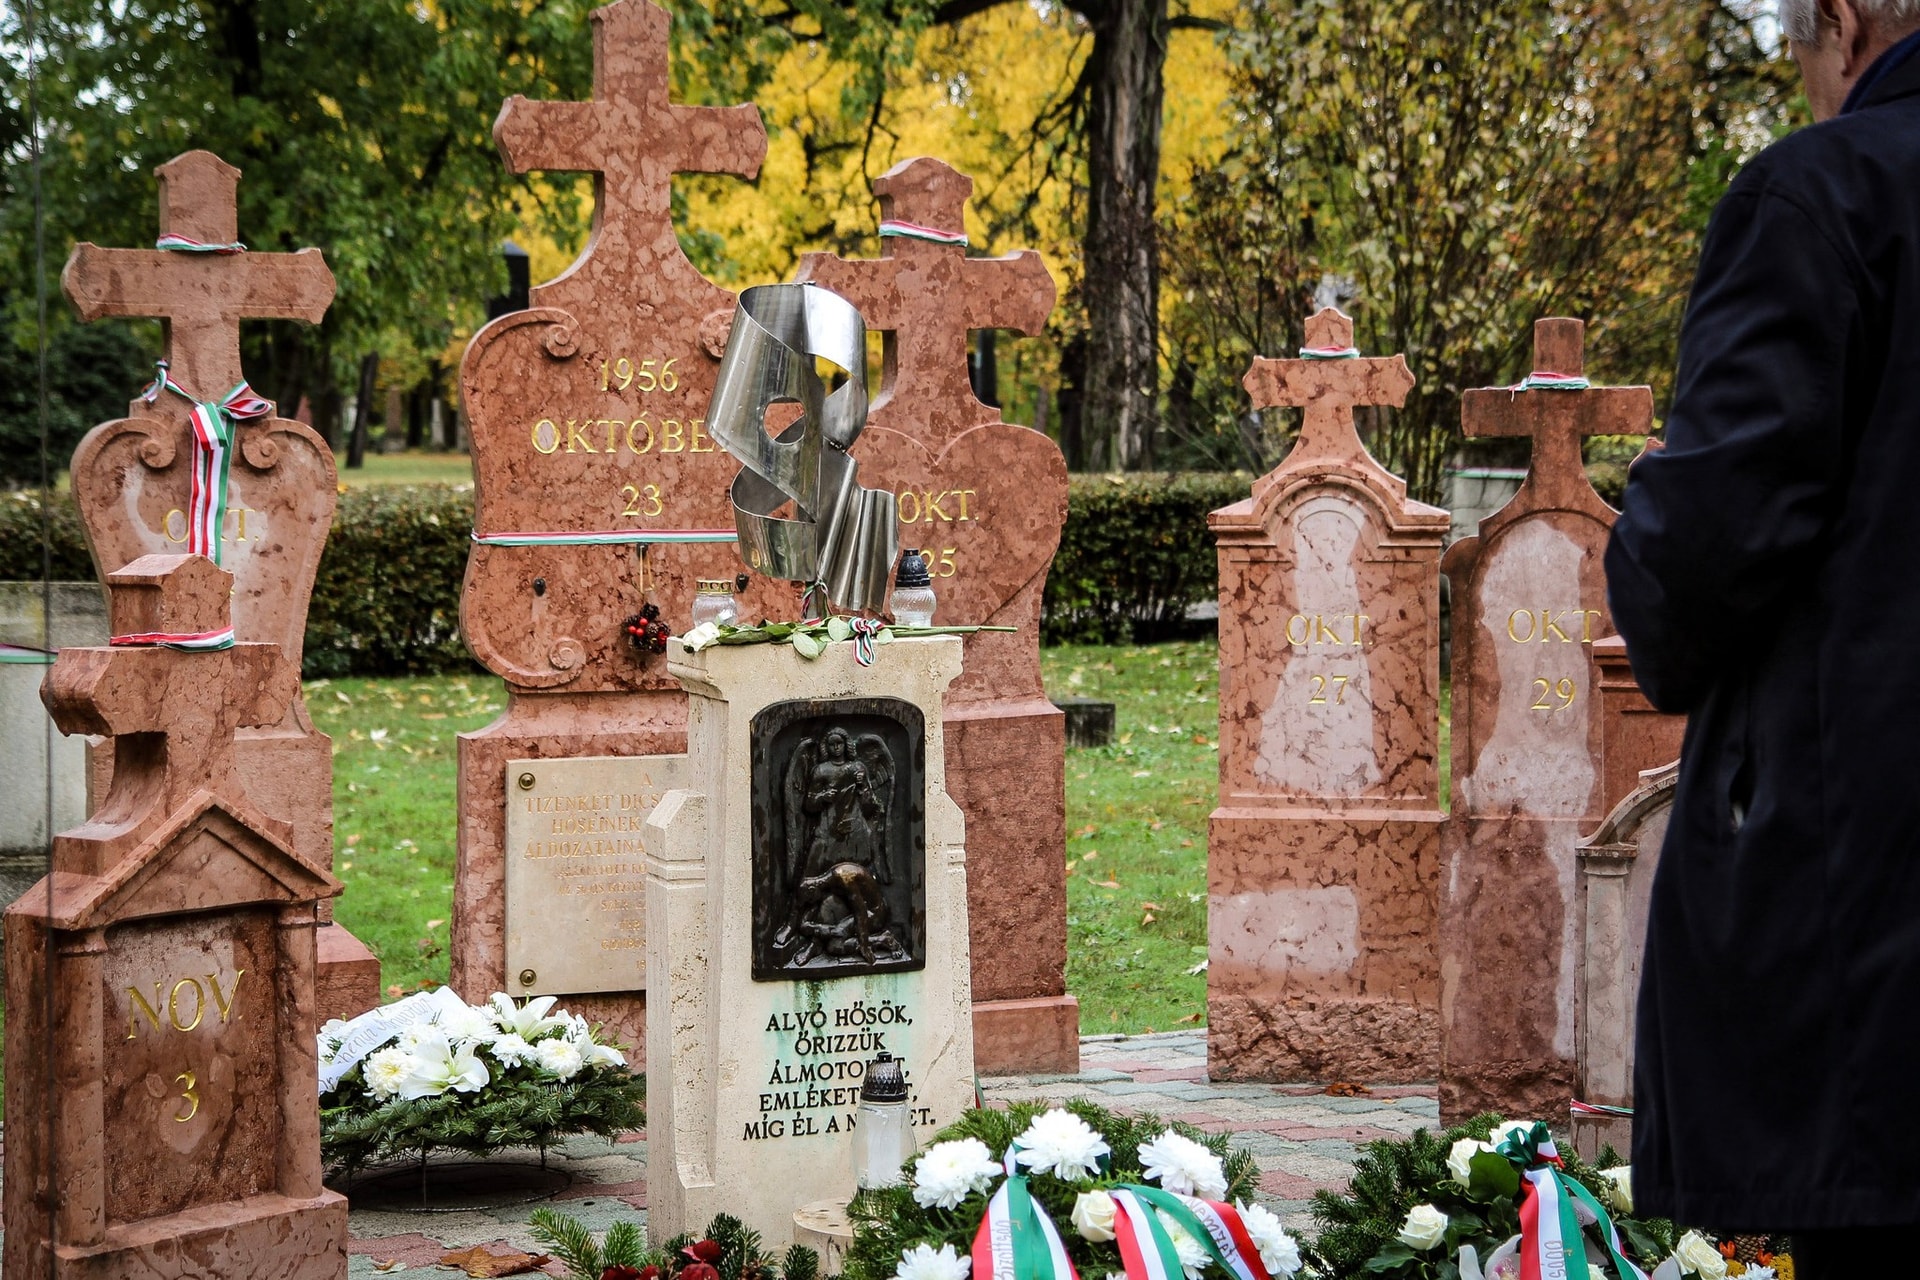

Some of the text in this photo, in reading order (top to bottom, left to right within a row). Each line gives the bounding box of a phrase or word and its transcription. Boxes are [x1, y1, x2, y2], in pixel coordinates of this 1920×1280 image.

[600, 358, 679, 392] 1956
[530, 411, 727, 455] OKTÓBE
[621, 484, 663, 518] 23
[898, 490, 979, 523] OKT.
[163, 508, 259, 543] OT.
[919, 548, 956, 577] 25
[1285, 614, 1373, 645] OKT.
[1507, 609, 1602, 644] OKT
[1307, 674, 1349, 705] 27
[1530, 677, 1577, 711] 29
[640, 772, 653, 789] A
[620, 792, 667, 812] DICS
[523, 837, 646, 860] ÁLDOZATAINA
[126, 969, 245, 1039] NOV.
[766, 1000, 913, 1031] ALVÓ HŐSÖK,
[795, 1028, 886, 1056] ŐRIZZÜK
[769, 1057, 910, 1084] ÁLMOTOT,
[174, 1070, 200, 1123] 3
[759, 1083, 918, 1111] EMLÉKETT,
[743, 1108, 936, 1140] MÍG ÉL A NET.
